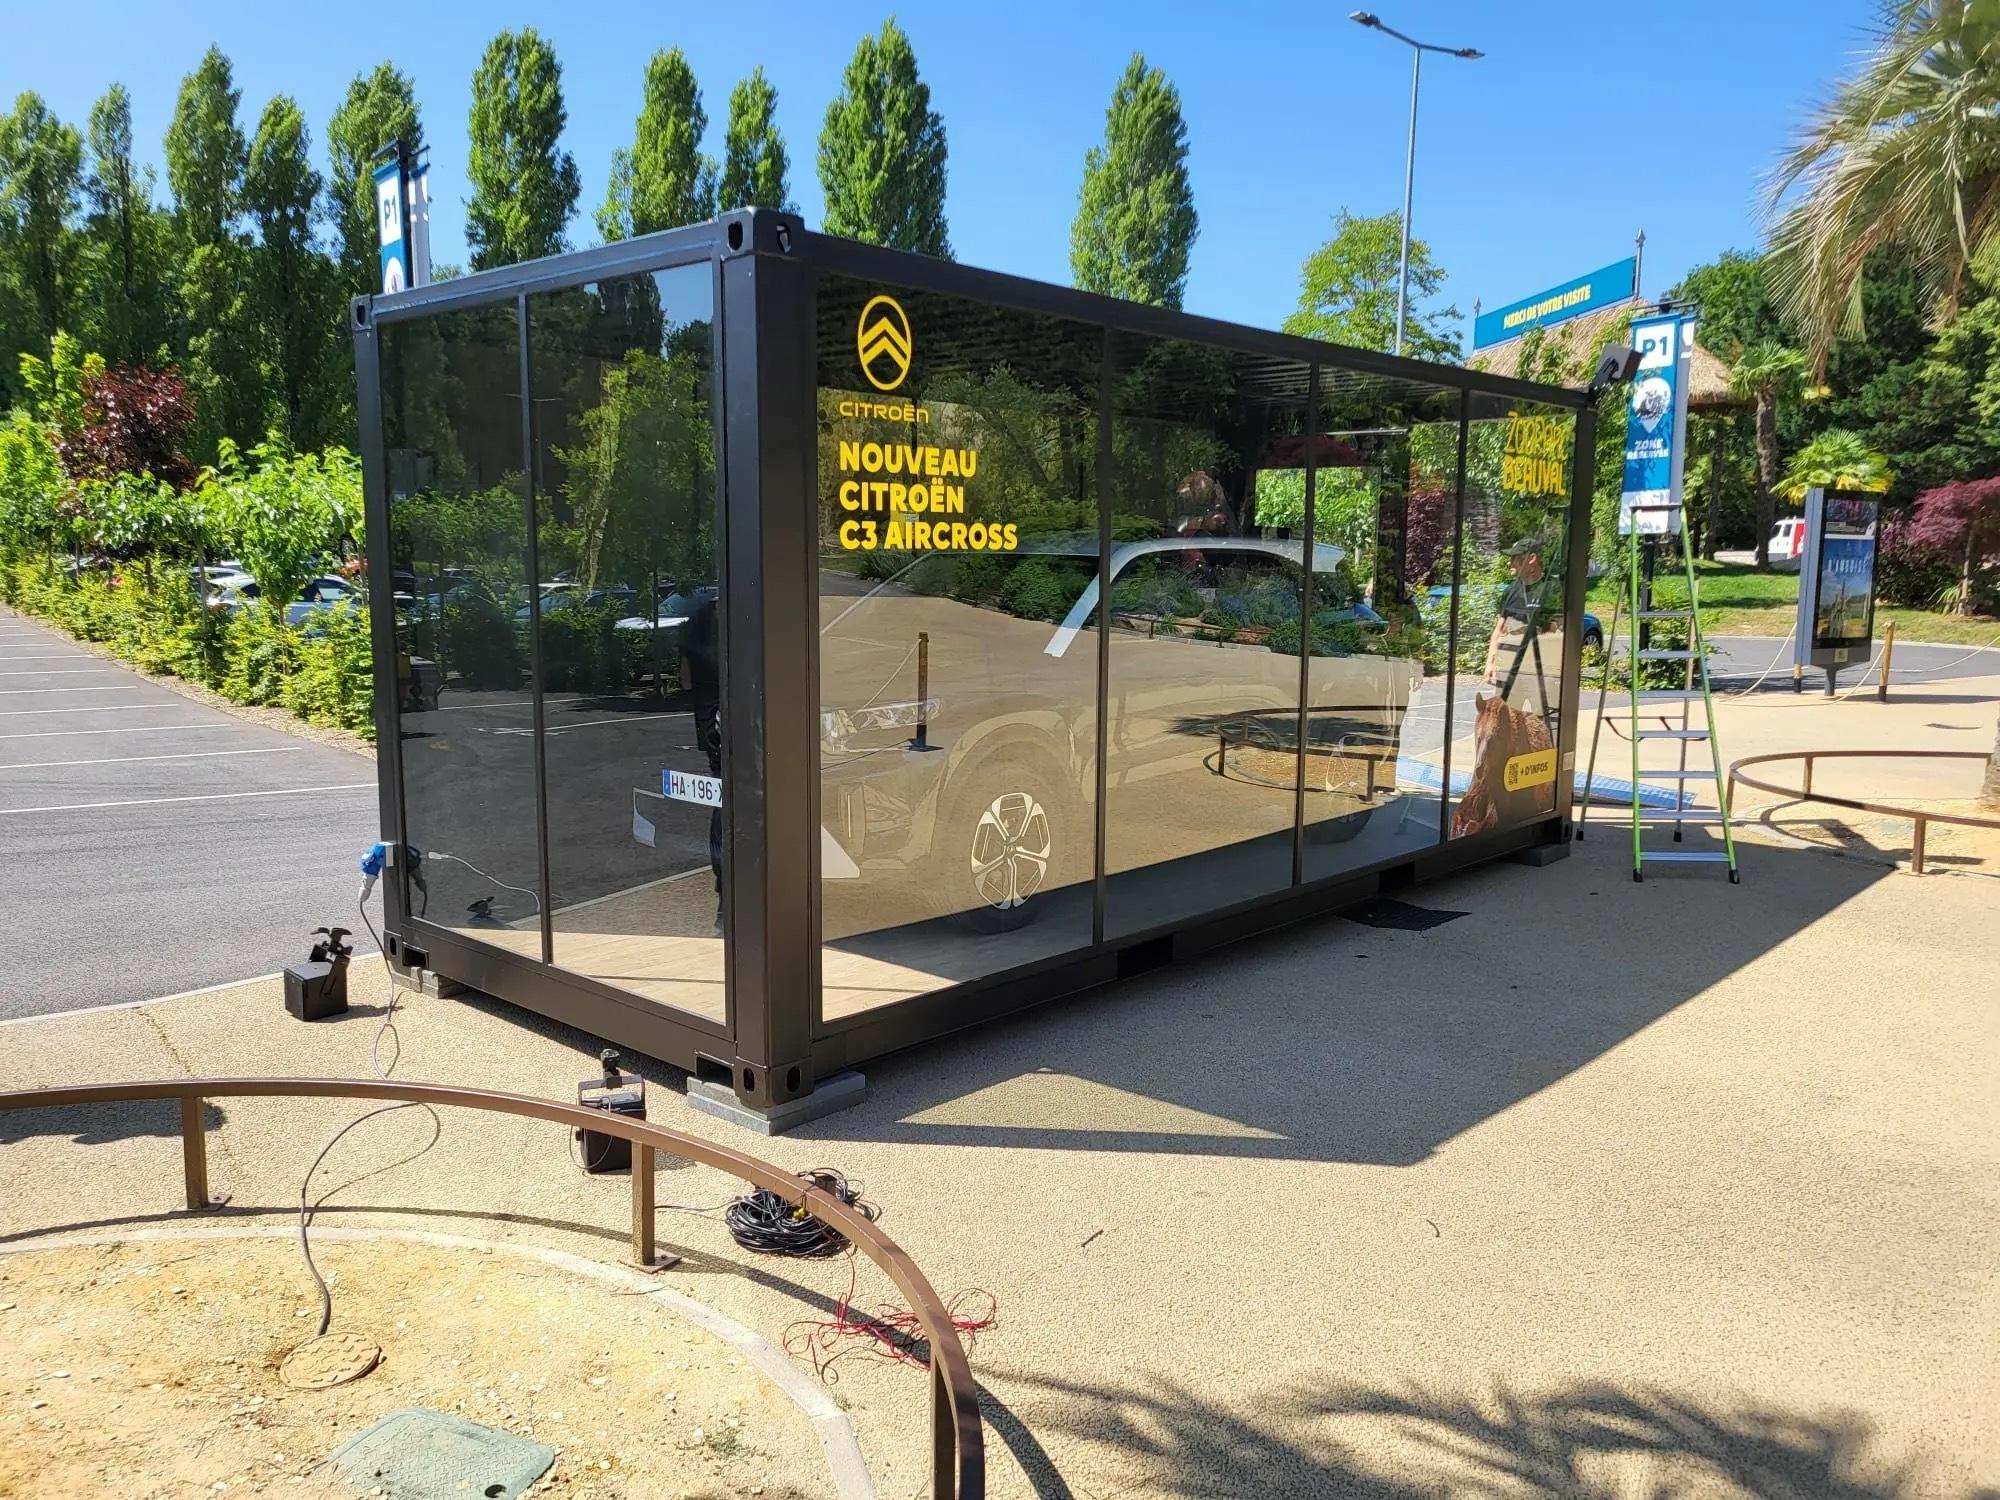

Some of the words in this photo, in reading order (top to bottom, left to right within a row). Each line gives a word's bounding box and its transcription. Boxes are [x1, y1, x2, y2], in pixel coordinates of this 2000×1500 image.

[383, 195, 398, 228] P1
[1503, 308, 1526, 330] MERCI
[1527, 304, 1537, 321] DE
[1537, 294, 1562, 318] VOTRE
[1563, 283, 1592, 309] VISITE
[1642, 335, 1668, 357] P1
[839, 441, 977, 478] NOUVEAU
[1634, 438, 1664, 451] ZONE
[1503, 455, 1566, 496] BEAUVAL
[839, 477, 964, 513] CITROËN
[839, 520, 878, 550] C3
[884, 521, 1018, 550] AIRCROSS
[1525, 762, 1549, 776] D'INFOS
